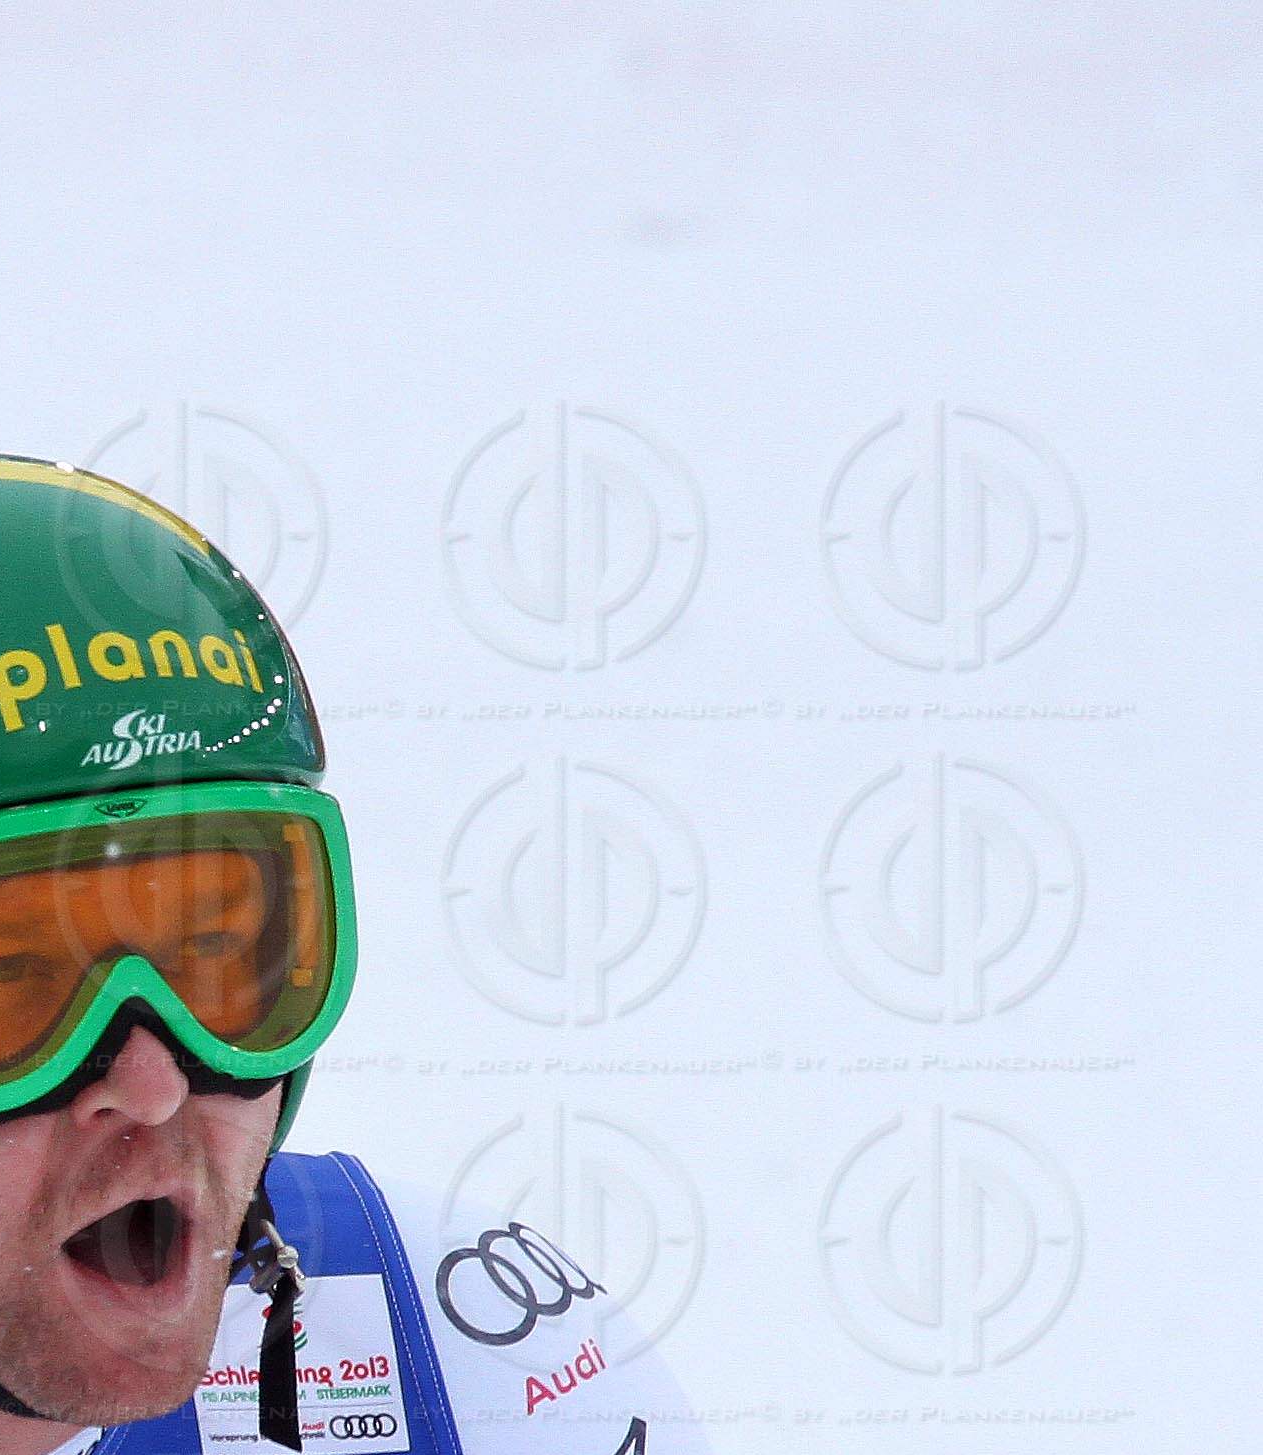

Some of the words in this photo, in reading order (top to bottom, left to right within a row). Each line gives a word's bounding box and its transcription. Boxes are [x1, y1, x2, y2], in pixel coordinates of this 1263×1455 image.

[80, 730, 201, 770] AUSTRIA
[338, 1355, 391, 1381] 2013
[524, 1338, 607, 1415] Audi
[316, 1384, 392, 1400] STEIERMARK
[301, 1421, 325, 1431] Audi
